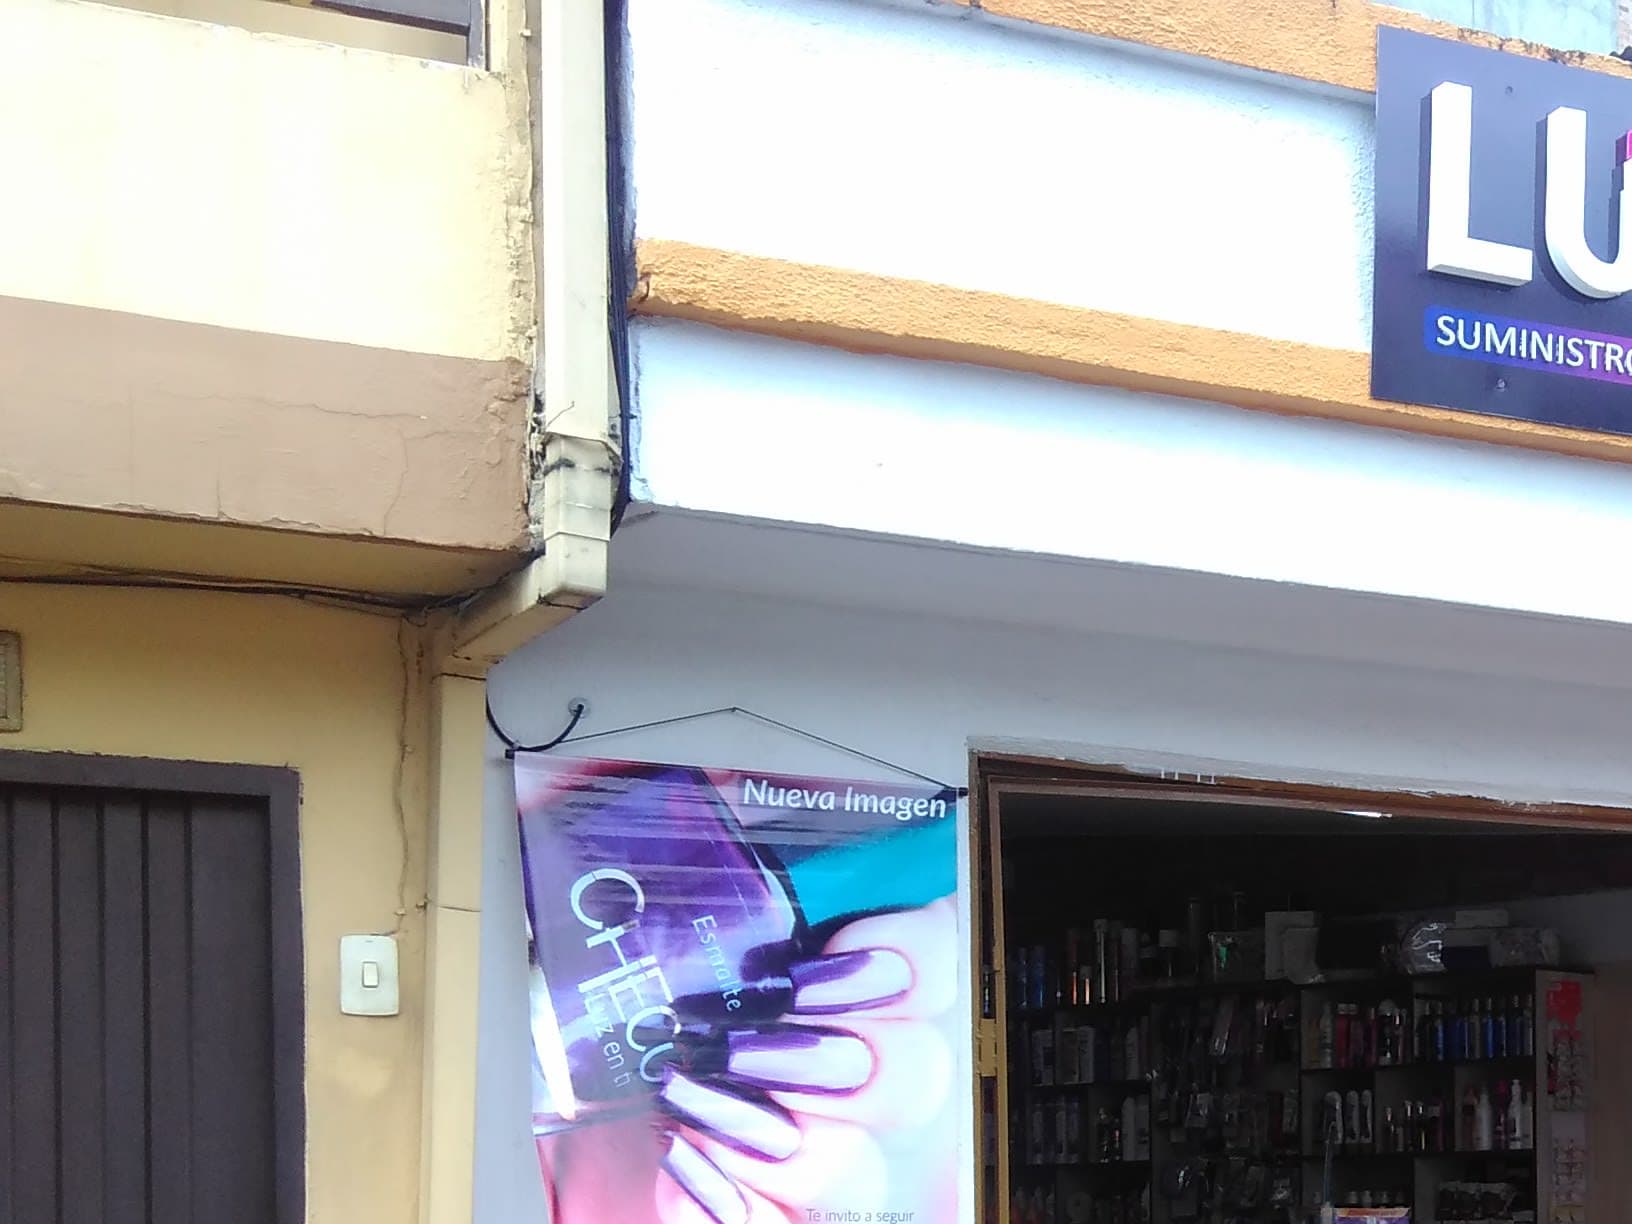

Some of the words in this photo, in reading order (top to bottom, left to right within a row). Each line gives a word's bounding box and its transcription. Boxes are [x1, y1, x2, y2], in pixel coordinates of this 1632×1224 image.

[743, 778, 835, 811] Nueva
[844, 786, 946, 820] Imagen
[571, 868, 682, 1083] CHECO
[692, 915, 742, 1012] Esmalte
[603, 1041, 625, 1070] en
[806, 1208, 821, 1222] Te
[825, 1209, 861, 1222] invito
[865, 1211, 872, 1222] a
[876, 1210, 915, 1224] seguir
